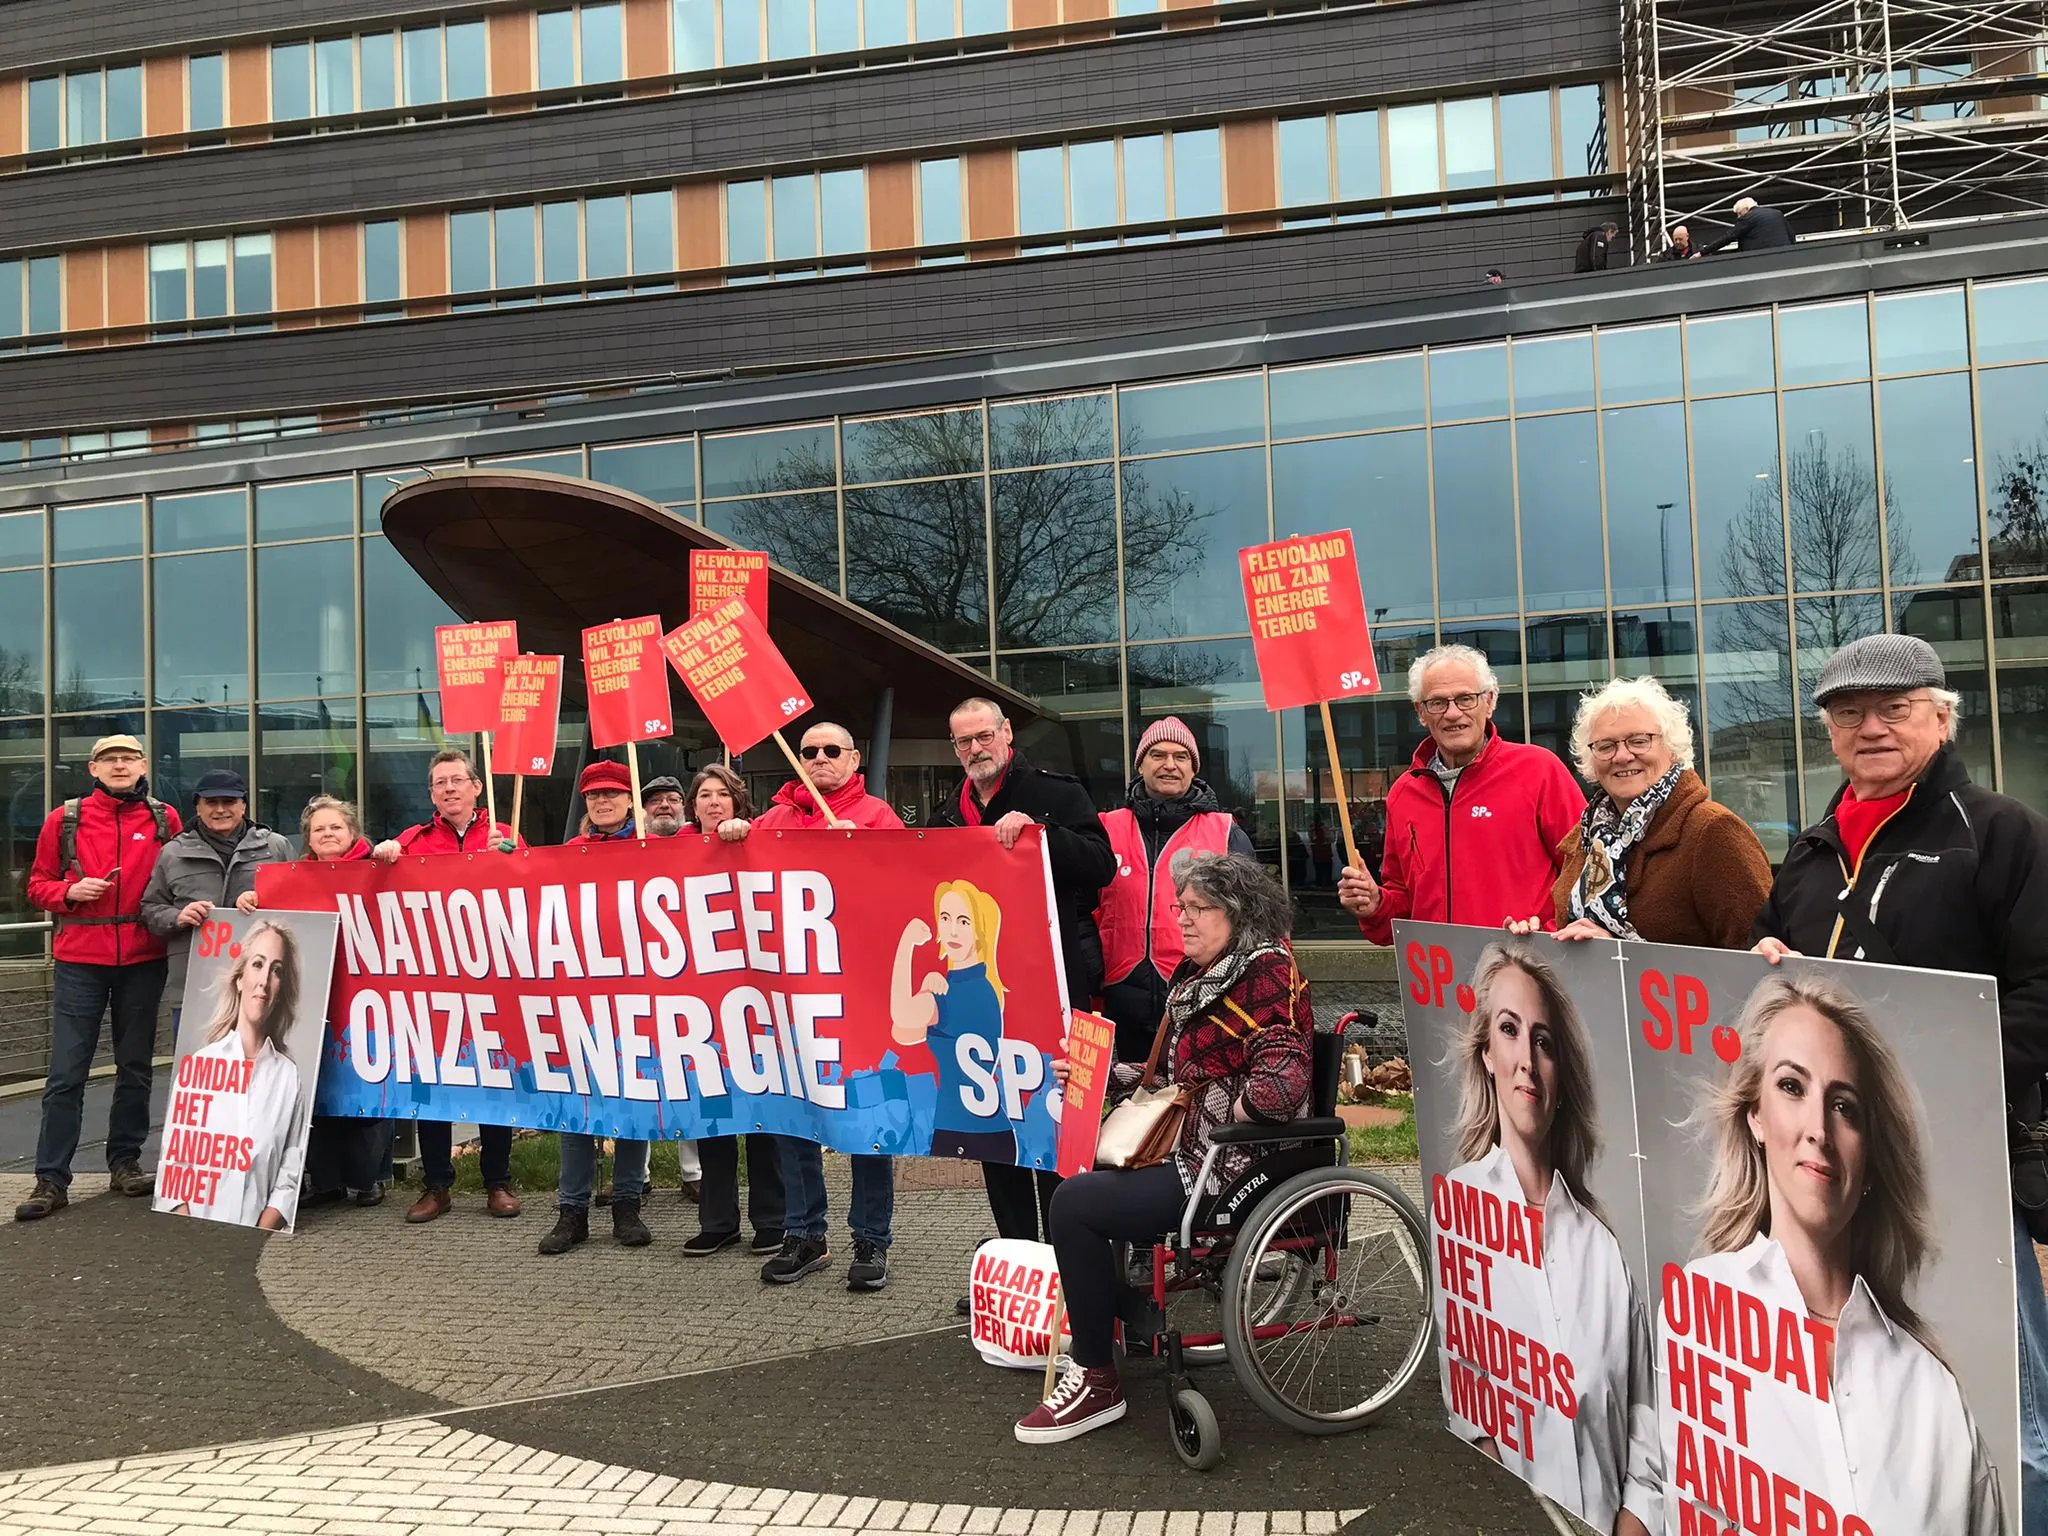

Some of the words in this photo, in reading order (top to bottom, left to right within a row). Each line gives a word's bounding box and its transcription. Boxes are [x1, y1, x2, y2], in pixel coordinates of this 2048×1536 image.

[695, 554, 763, 570] FLEVOLAND
[1248, 538, 1346, 573] FLEVOLAND
[695, 570, 718, 583] WIL
[722, 570, 750, 584] ZIJN
[1251, 574, 1286, 595] WIL
[1289, 563, 1331, 588] ZIJN
[1254, 586, 1330, 618] ENERGIE
[441, 625, 512, 643] FLEVOLAND
[587, 621, 655, 647] FLEVOLAND
[666, 601, 745, 655] FLEVOLAND
[1257, 610, 1317, 639] TERUG
[443, 644, 466, 657] WIL
[470, 641, 499, 655] ZIJN
[443, 656, 496, 672] ENERGIE
[589, 646, 611, 663] WIL
[613, 639, 643, 658] ZIJN
[676, 645, 709, 670] WIL
[705, 624, 742, 654] ZIJN
[688, 642, 749, 687] ENERGIE
[445, 671, 485, 686] TERUG
[504, 660, 557, 675] FLEVOLAND
[504, 677, 518, 690] WIL
[520, 676, 545, 690] ZIJN
[590, 656, 641, 680] ENERGIE
[592, 674, 630, 696] TERUG
[698, 666, 747, 702] TERUG
[501, 708, 526, 722] TERUG
[502, 692, 540, 706] ENERGIE
[336, 870, 843, 980] NATIONALISEER
[350, 989, 514, 1089] ONZE
[519, 985, 847, 1110] ENERGIE
[1072, 1016, 1110, 1049] FLEVOLAND
[1081, 1044, 1099, 1069] ZIJN
[178, 1054, 255, 1095] OMDAT
[172, 1092, 214, 1128] HET
[166, 1128, 253, 1172] ANDERS
[161, 1165, 222, 1206] MOET
[1228, 1173, 1269, 1212] MEYRA
[1433, 1173, 1544, 1270] OMDAT
[974, 1253, 1043, 1297] NAAR
[1438, 1235, 1492, 1312] HET
[973, 1284, 1041, 1327] BETER
[1662, 1262, 1833, 1404] OMDAT
[1446, 1308, 1579, 1421] ANDERS
[1450, 1358, 1536, 1463] MOET
[1668, 1338, 1752, 1448] HET
[1675, 1420, 1874, 1536] ANDER
